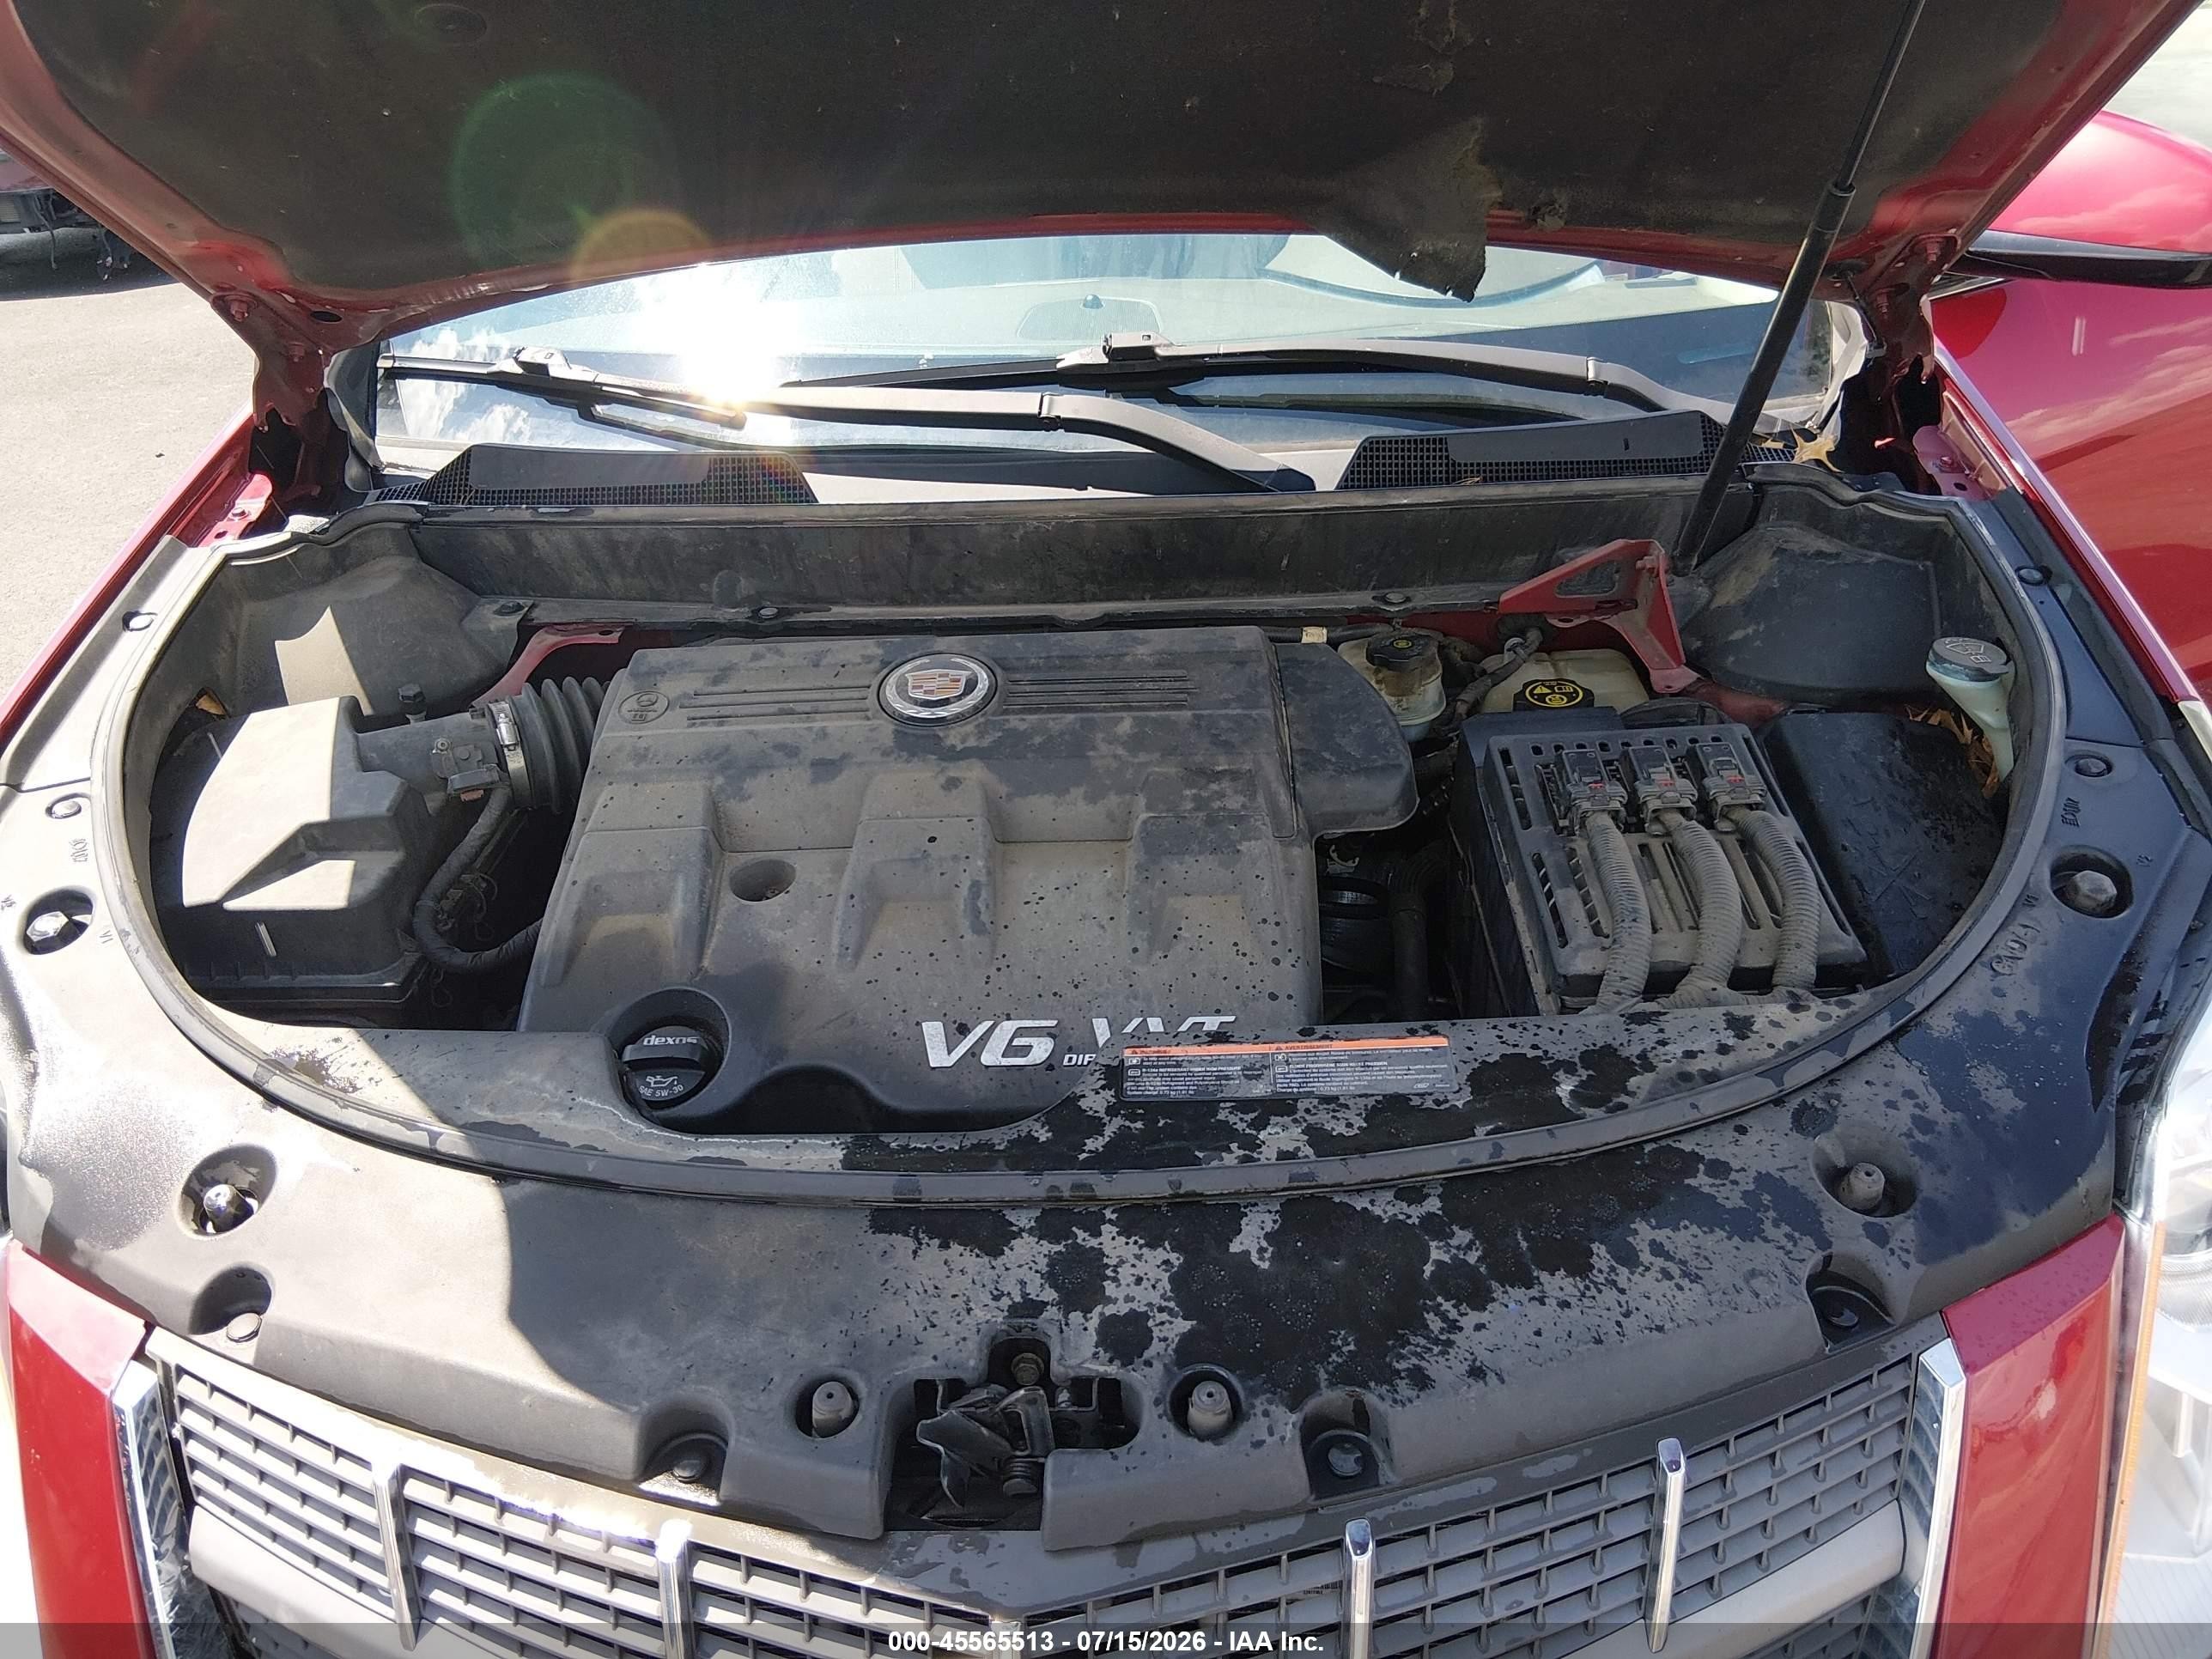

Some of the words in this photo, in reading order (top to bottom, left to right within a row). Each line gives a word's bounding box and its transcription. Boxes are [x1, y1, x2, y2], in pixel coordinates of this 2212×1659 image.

[643, 1035, 699, 1045] dexos
[921, 1019, 1059, 1067] V6
[638, 1085, 653, 1097] SAE
[655, 1084, 684, 1097] 5W-30
